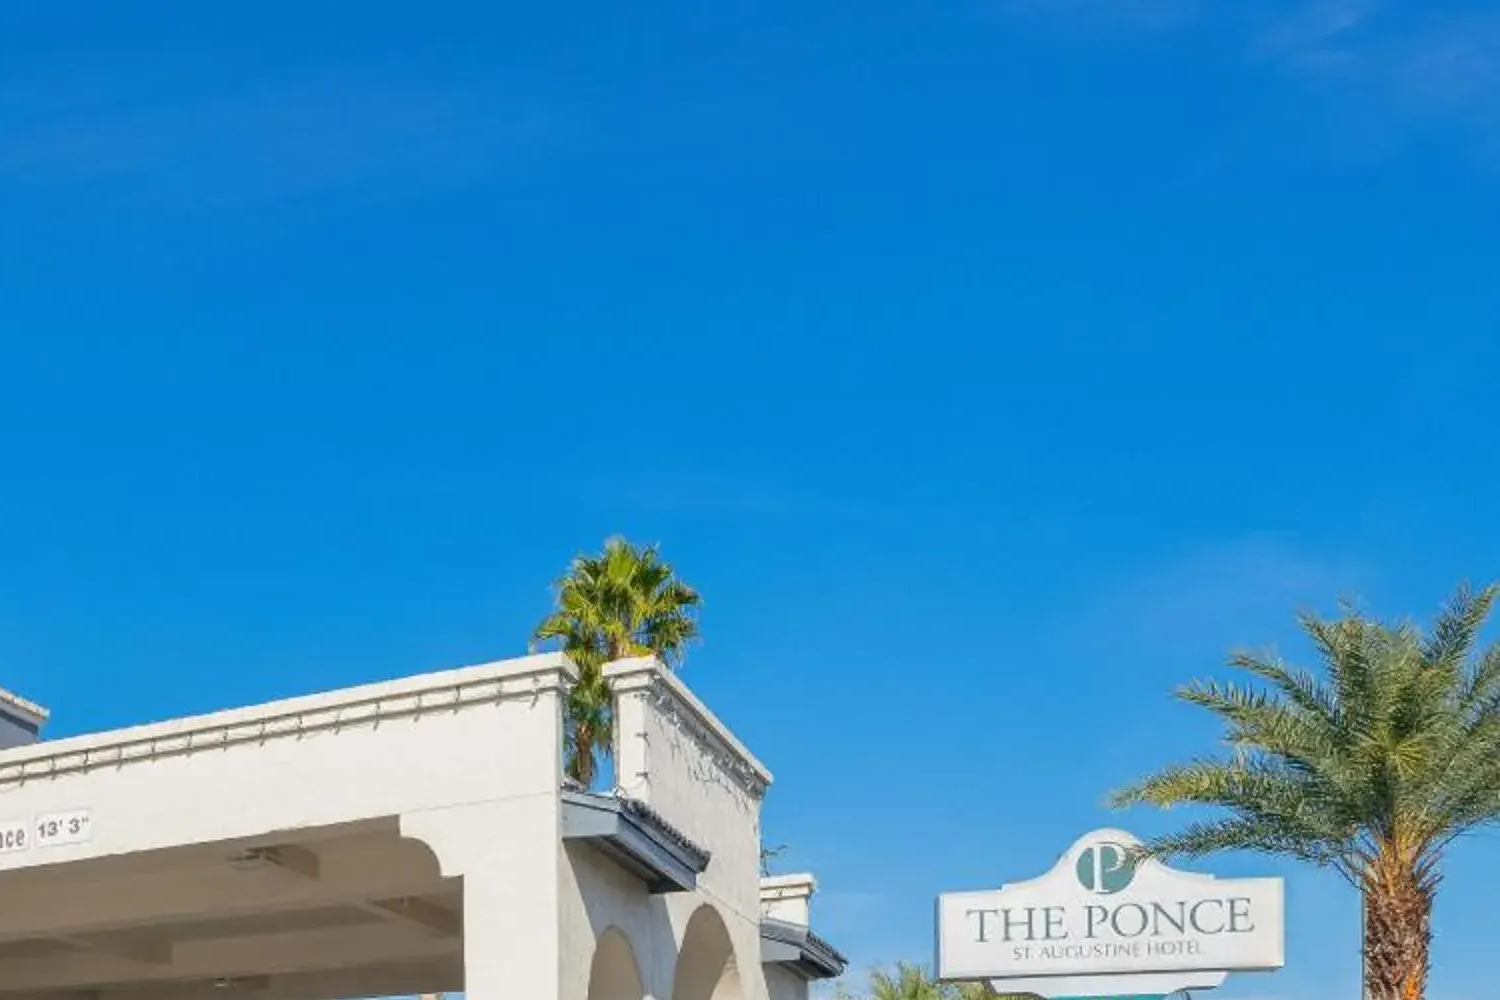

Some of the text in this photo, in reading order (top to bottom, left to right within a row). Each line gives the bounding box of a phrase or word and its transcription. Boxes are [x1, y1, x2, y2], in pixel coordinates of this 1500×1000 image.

[38, 819, 63, 839] 13'
[1092, 841, 1126, 894] P
[966, 897, 1255, 943] THE PONCE
[1041, 943, 1141, 959] AUGUSTINE
[1147, 940, 1201, 957] HOTEL
